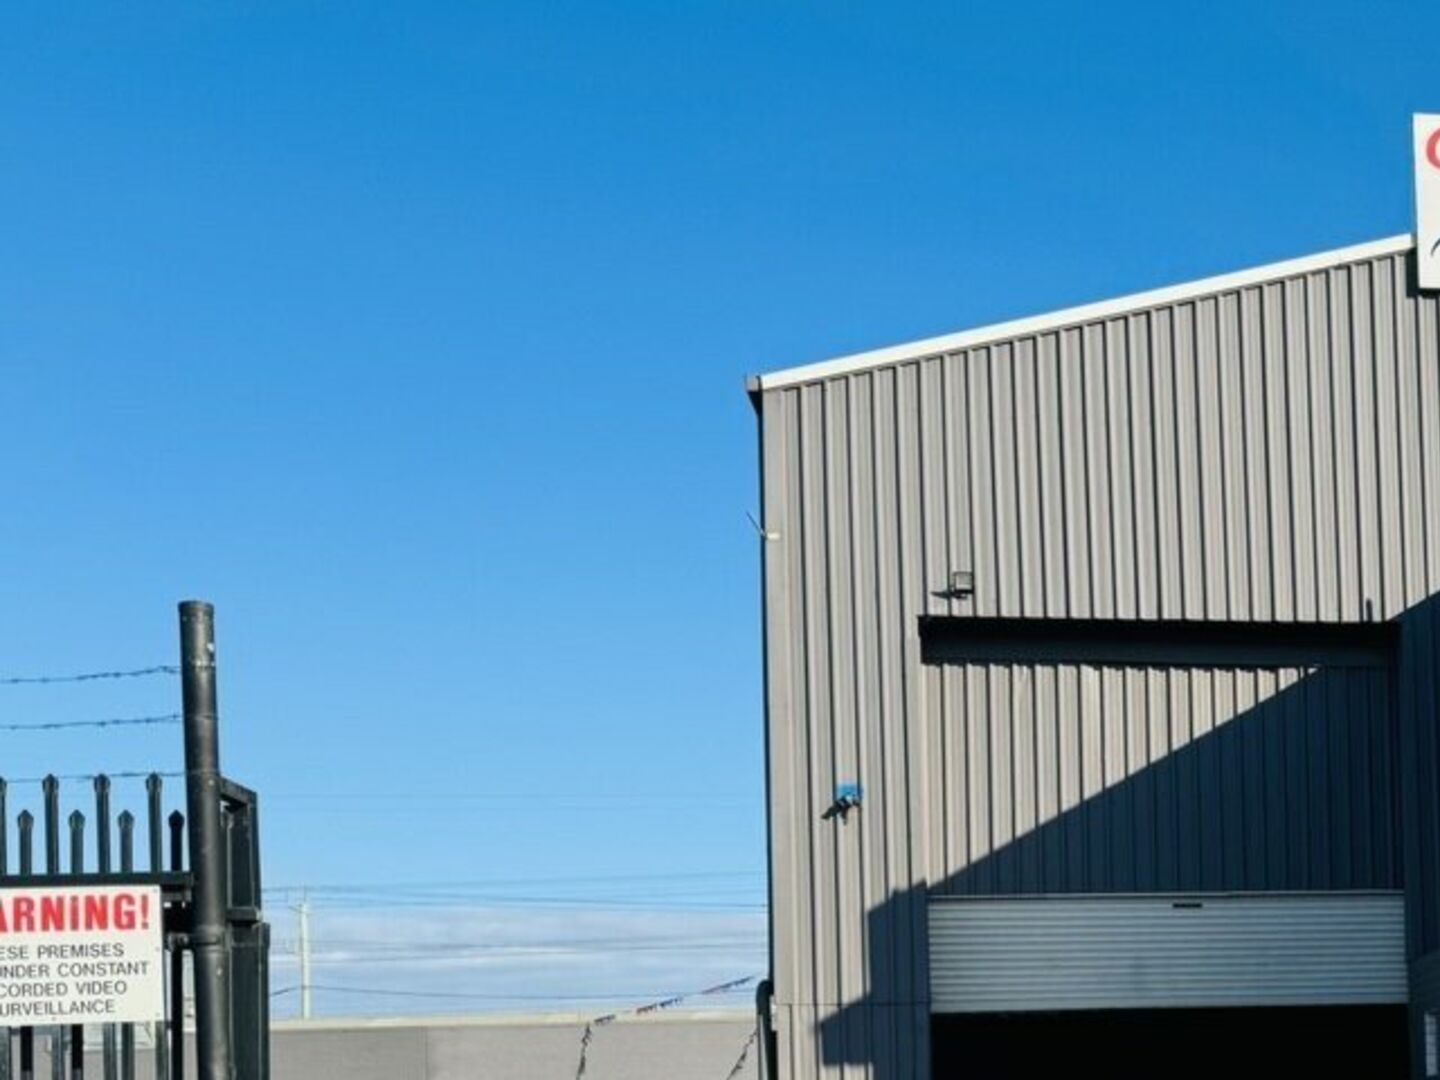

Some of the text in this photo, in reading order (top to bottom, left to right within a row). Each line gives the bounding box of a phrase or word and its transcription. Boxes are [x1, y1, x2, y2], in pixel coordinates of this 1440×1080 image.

[37, 942, 124, 959] PREMISES
[0, 961, 148, 979] NDER CONSTANT
[76, 980, 127, 996] VIDEO
